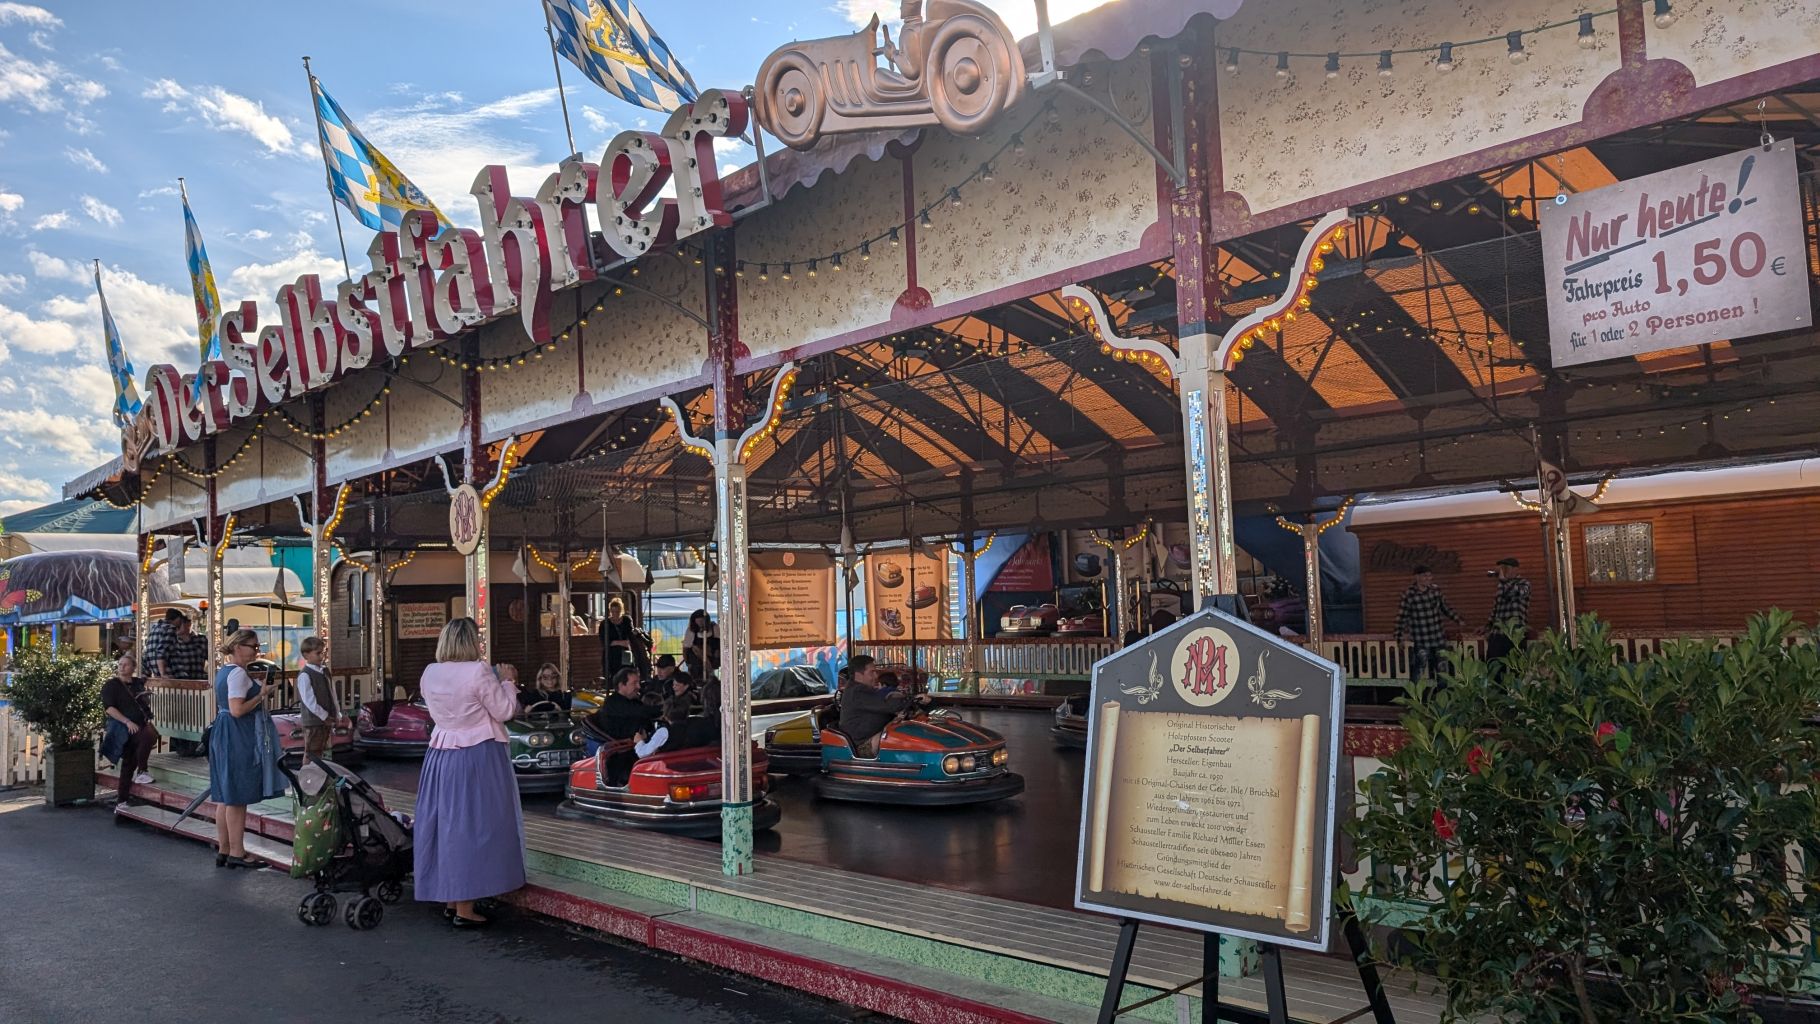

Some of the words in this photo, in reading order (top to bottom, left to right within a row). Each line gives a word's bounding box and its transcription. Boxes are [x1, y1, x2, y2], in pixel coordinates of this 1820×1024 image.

[1565, 210, 1629, 261] Nur
[145, 363, 232, 452] Der
[219, 88, 750, 424] Selbstfahrer
[1562, 269, 1643, 303] Fahrpreis
[1652, 231, 1767, 297] 1,50
[1770, 256, 1787, 276] €
[1582, 309, 1607, 327] pro
[1610, 299, 1651, 318] Auto
[1569, 330, 1588, 352] für
[1590, 329, 1598, 344] 1
[1600, 325, 1625, 343] oder
[1628, 320, 1640, 337] 2
[1646, 302, 1745, 335] Personen
[1752, 297, 1760, 314] !
[1167, 719, 1194, 730] Original
[1195, 721, 1236, 731] Historischer
[1208, 733, 1234, 744] Scooter
[1201, 757, 1232, 769] Eigenbau
[1172, 767, 1198, 779] Baujahr
[1197, 783, 1209, 791] der
[1166, 792, 1178, 800] den
[1160, 815, 1180, 826] Leben
[1180, 820, 1206, 830] erweckt
[1222, 824, 1235, 832] von
[1235, 812, 1249, 821] und
[1129, 824, 1167, 837] Schausteller
[1167, 828, 1192, 840] Familie
[1192, 832, 1219, 843] Richard
[1245, 838, 1266, 849] Essen
[1196, 846, 1209, 855] seit
[1239, 850, 1262, 862] Jahren
[1220, 861, 1232, 870] der
[1156, 865, 1197, 880] Gesellschaft
[1198, 870, 1233, 883] Deutscher
[1233, 875, 1277, 890] Schausteller
